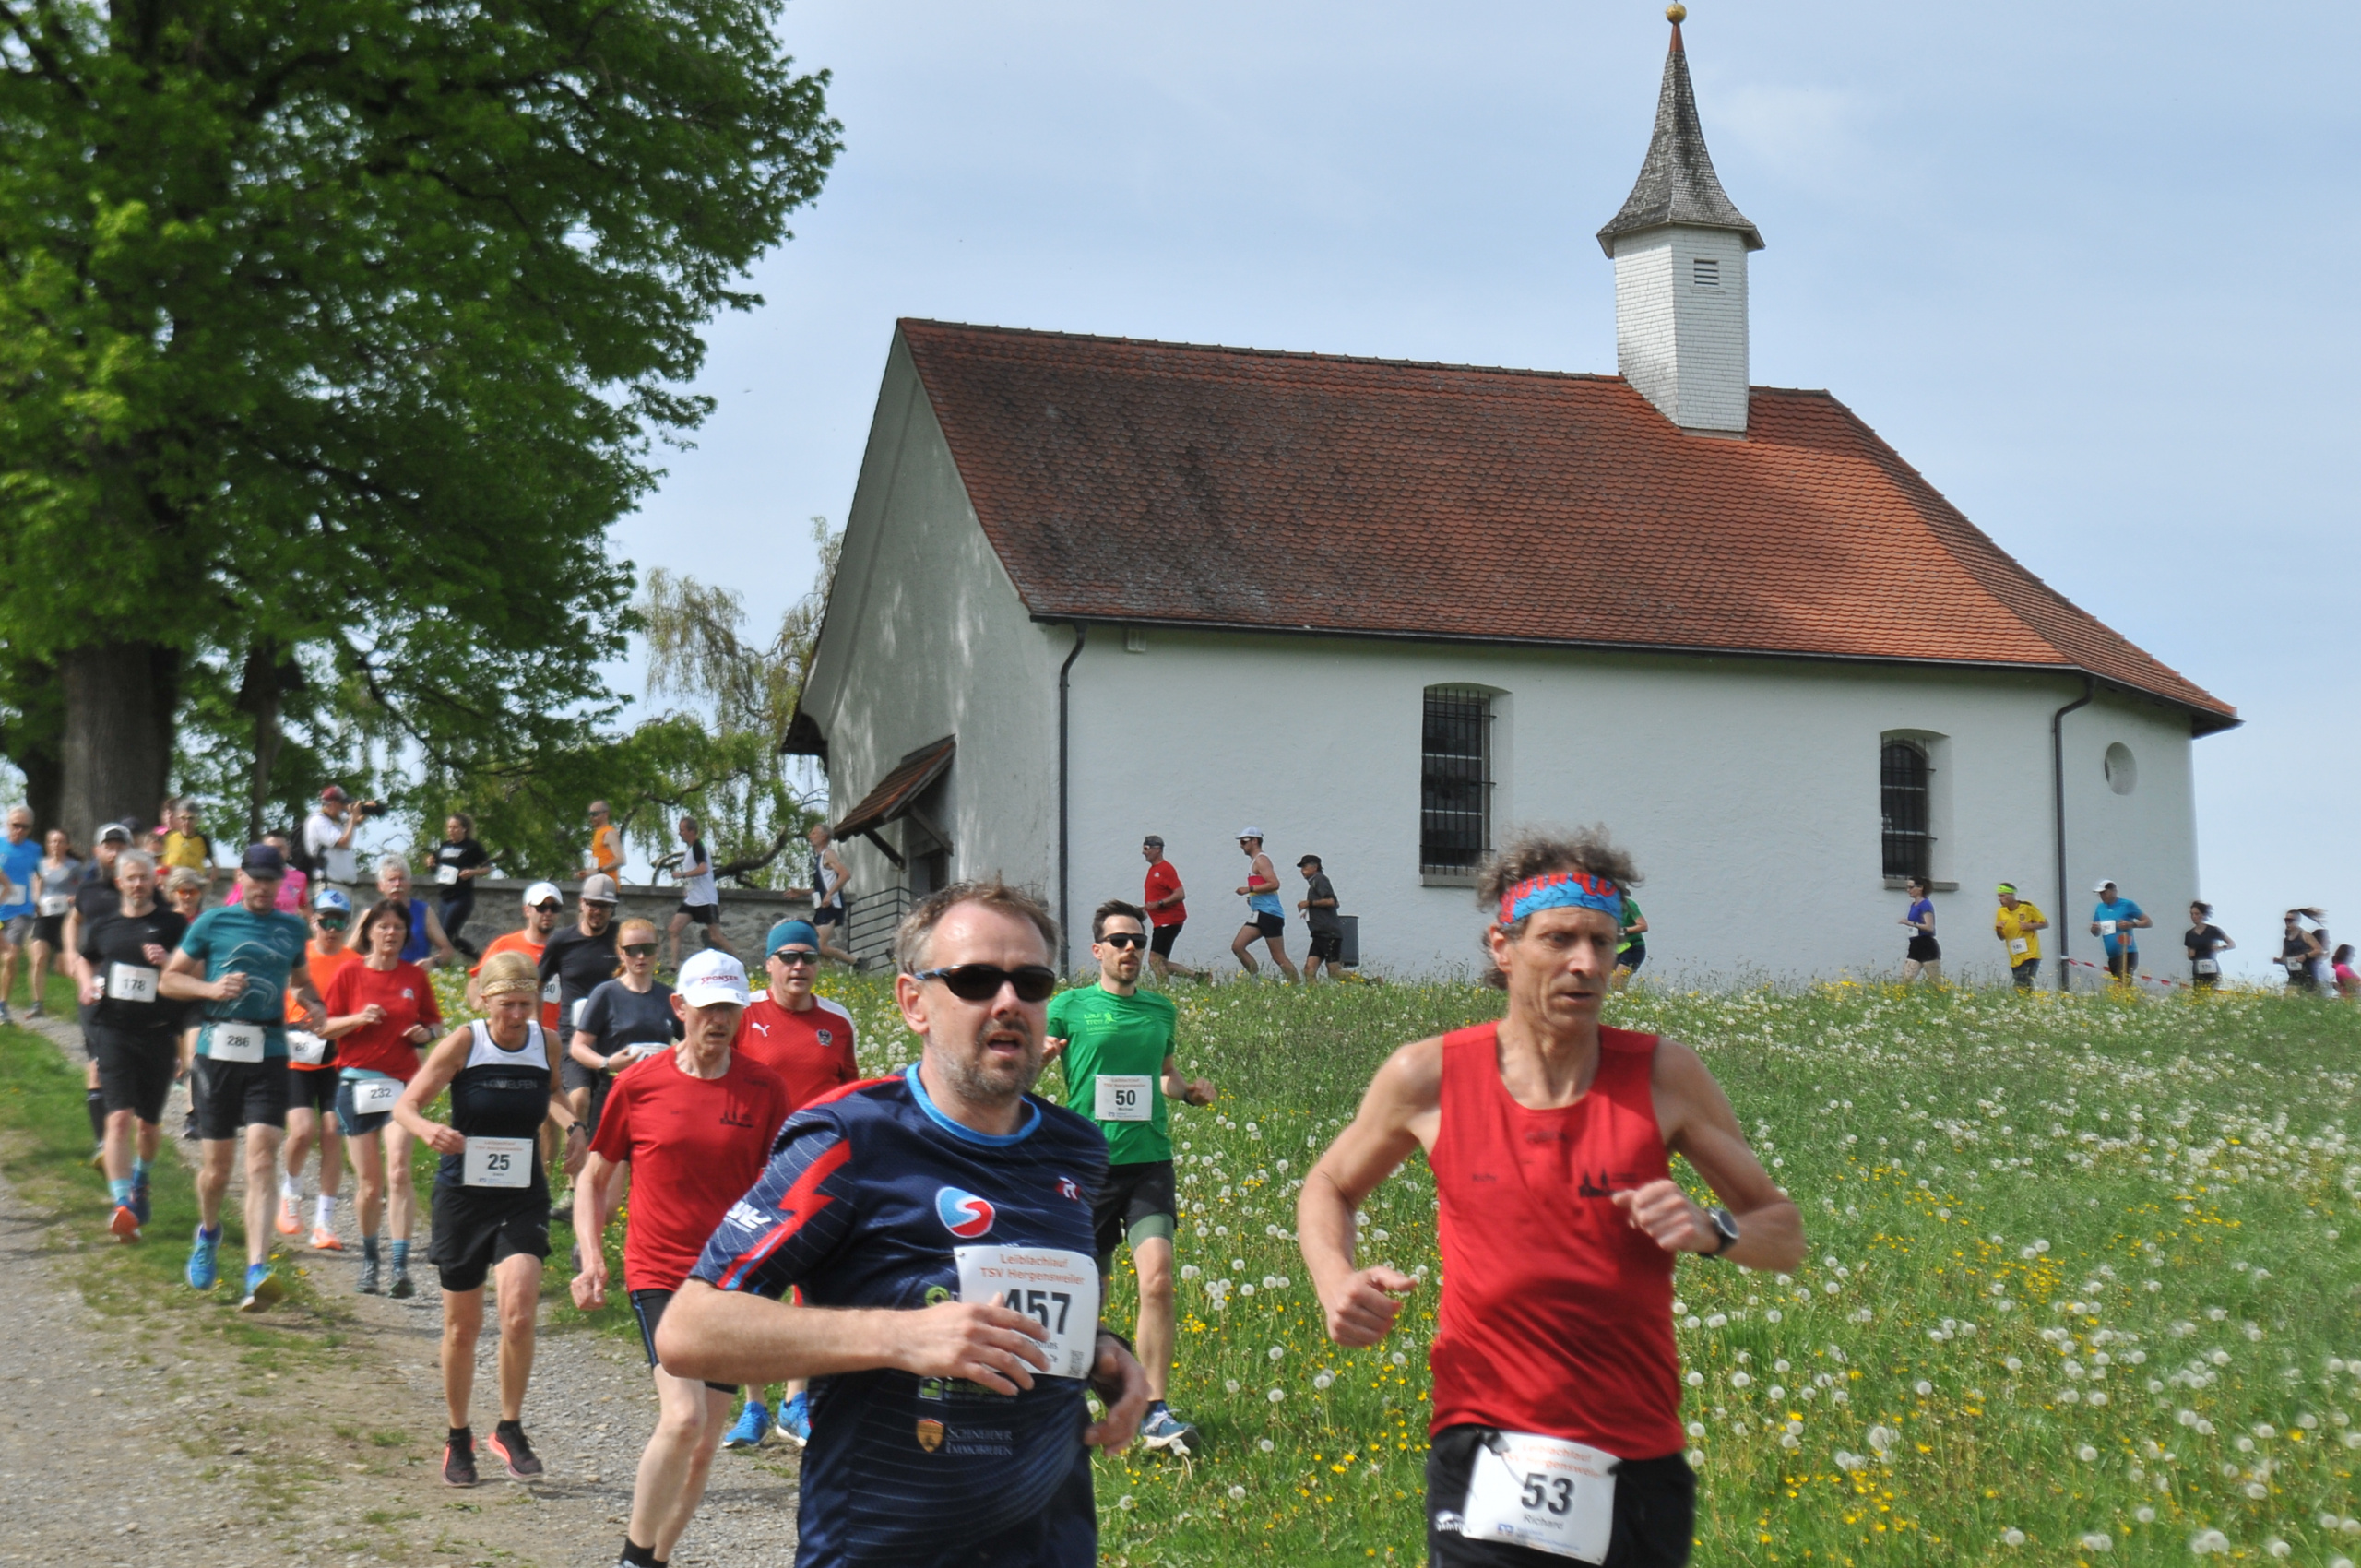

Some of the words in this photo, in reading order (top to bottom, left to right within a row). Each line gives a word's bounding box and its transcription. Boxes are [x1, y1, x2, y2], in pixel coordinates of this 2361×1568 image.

[124, 979, 146, 992] 178
[227, 1035, 250, 1048] 286
[370, 1088, 392, 1099] 232
[1115, 1089, 1136, 1106] 50
[488, 1153, 510, 1170] 25
[1000, 1253, 1069, 1268] Leiblachlauf
[980, 1267, 1004, 1278] TSV
[1007, 1268, 1086, 1285] Hergensweiler
[1521, 1472, 1575, 1516] 53
[1524, 1514, 1563, 1531] Richard
